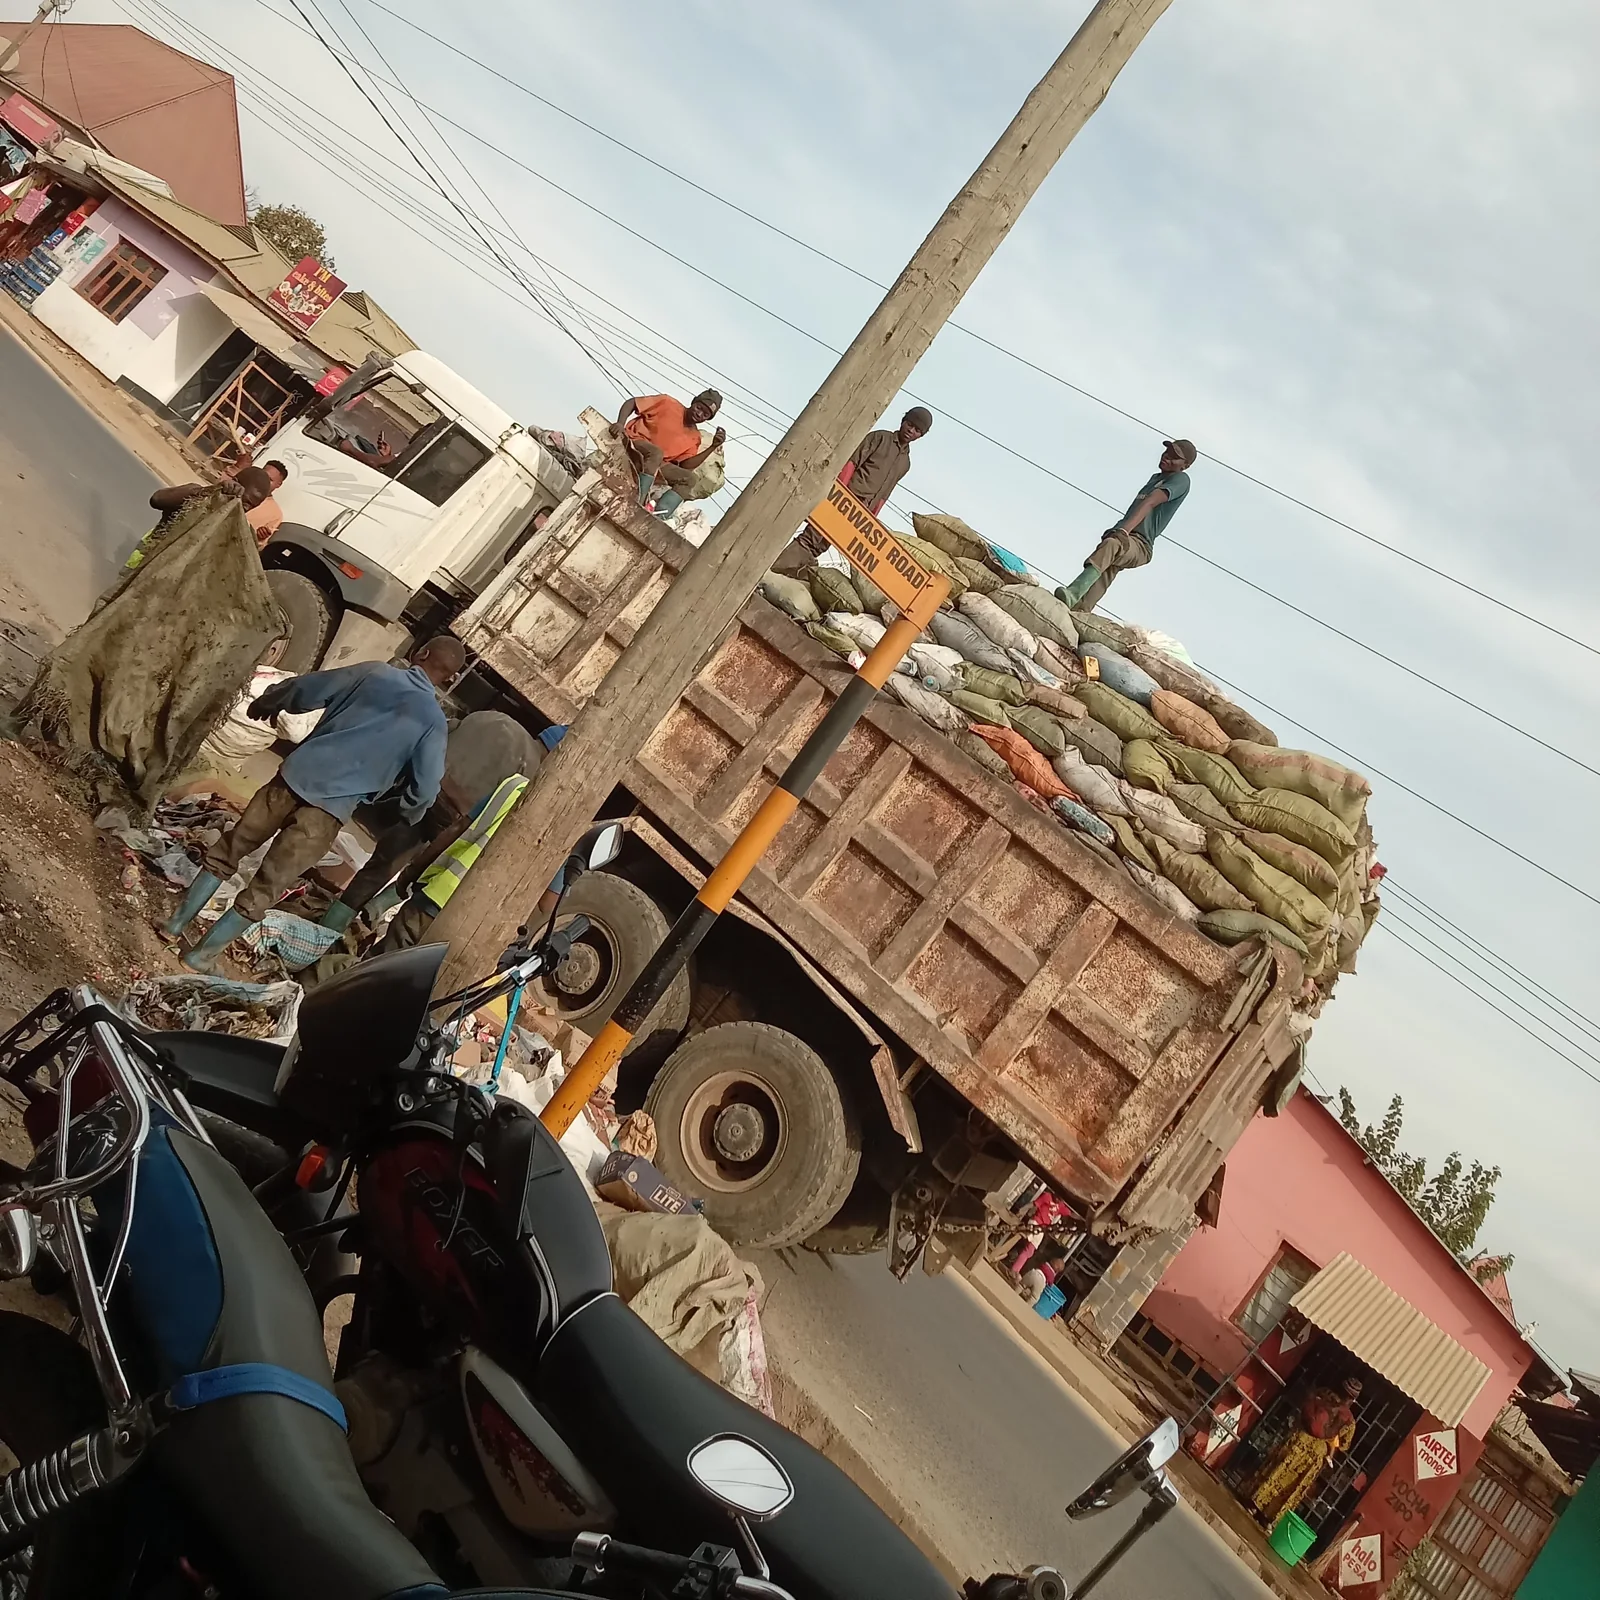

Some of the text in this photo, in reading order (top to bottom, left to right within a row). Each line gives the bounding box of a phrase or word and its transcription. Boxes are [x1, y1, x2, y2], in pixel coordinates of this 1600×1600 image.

[292, 271, 309, 285] cake
[313, 285, 333, 303] bites
[847, 536, 880, 573] INN
[886, 549, 925, 589] ROAD
[653, 1190, 682, 1213] LITE
[403, 1167, 506, 1271] BOXER
[1418, 1448, 1448, 1477] money
[1419, 1434, 1456, 1470] AIRTEL
[1385, 1491, 1413, 1522] ZIPO
[1392, 1473, 1431, 1520] VOCHA
[1343, 1552, 1367, 1581] PESA
[1351, 1539, 1377, 1572] halo
